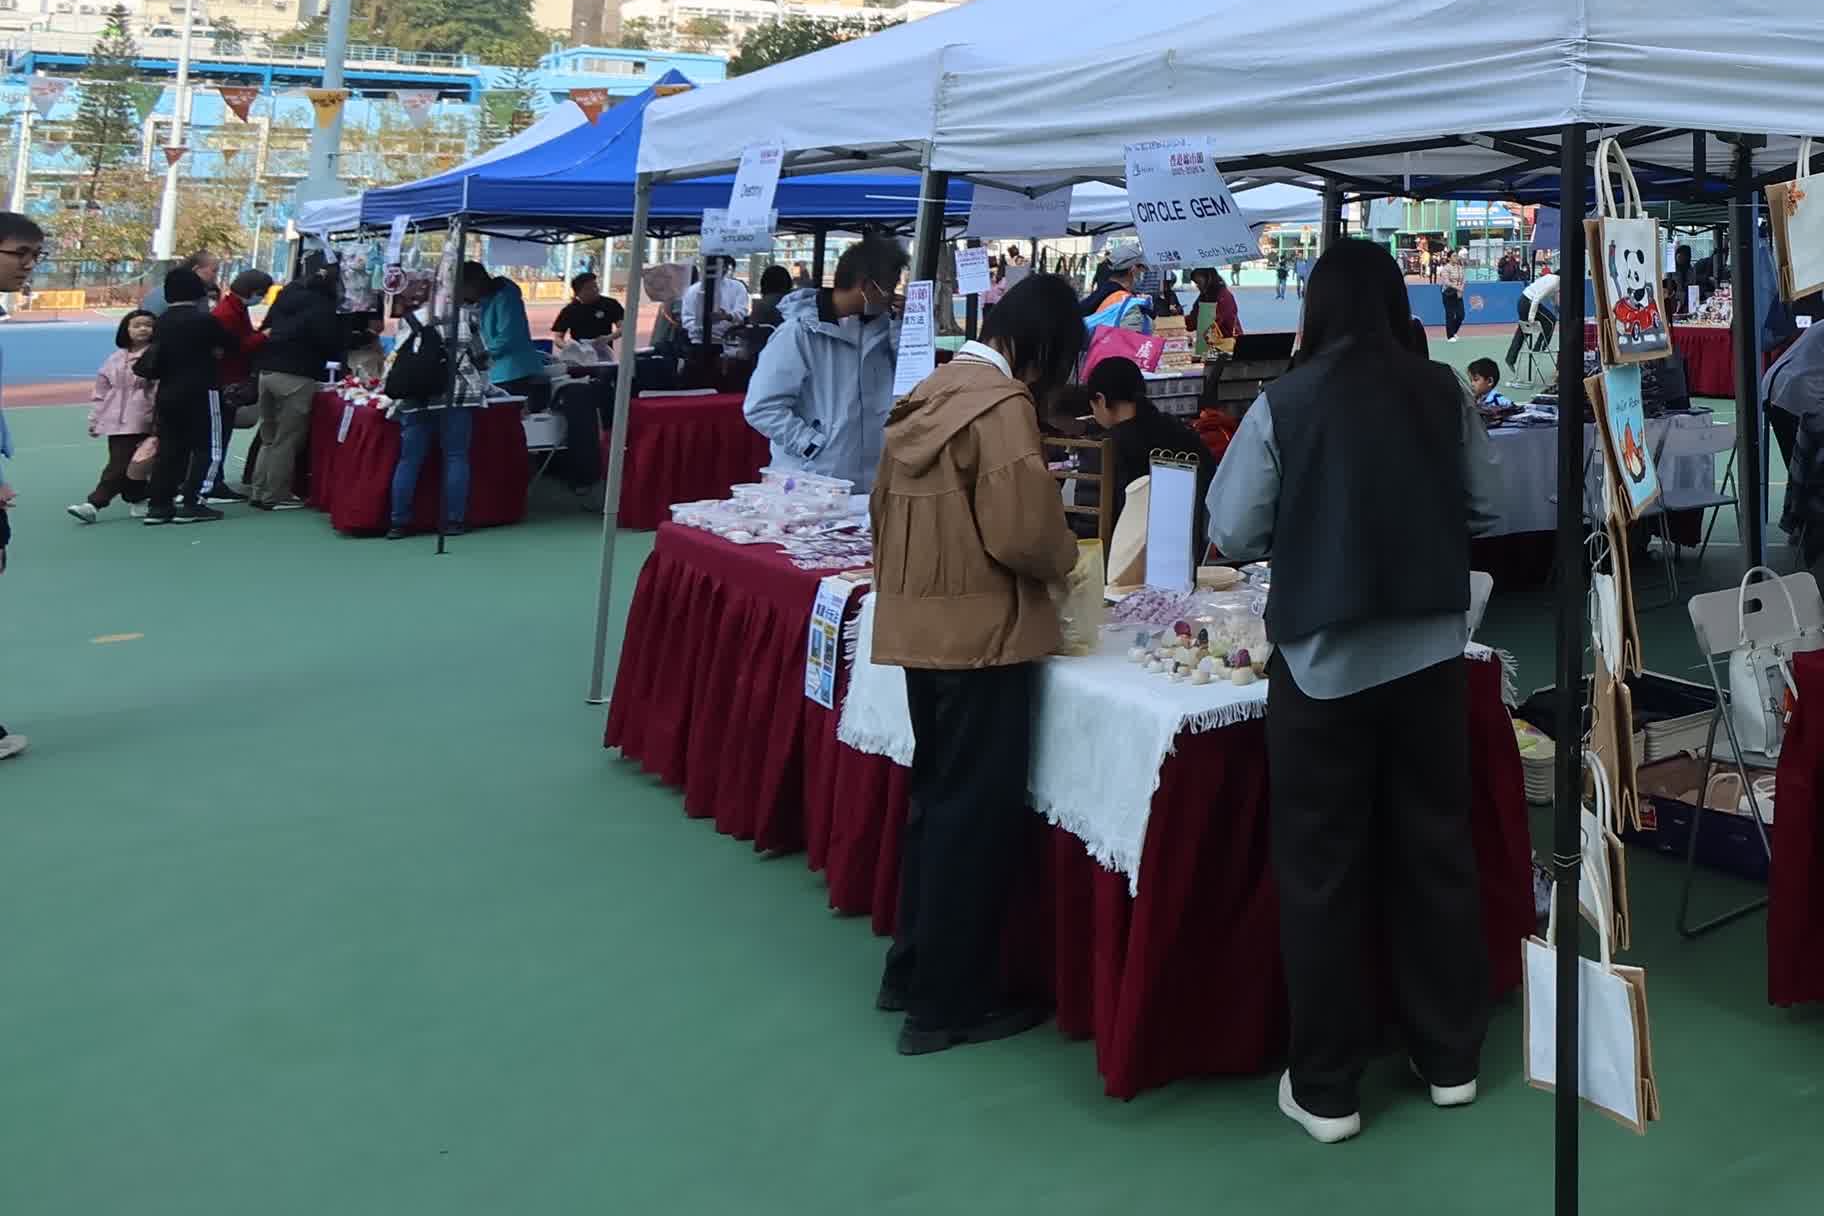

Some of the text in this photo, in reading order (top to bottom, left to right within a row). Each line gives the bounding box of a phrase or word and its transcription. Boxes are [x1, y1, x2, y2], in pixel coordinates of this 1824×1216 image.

[1136, 194, 1231, 223] CIRCLE GEM
[1197, 248, 1221, 259] Booth
